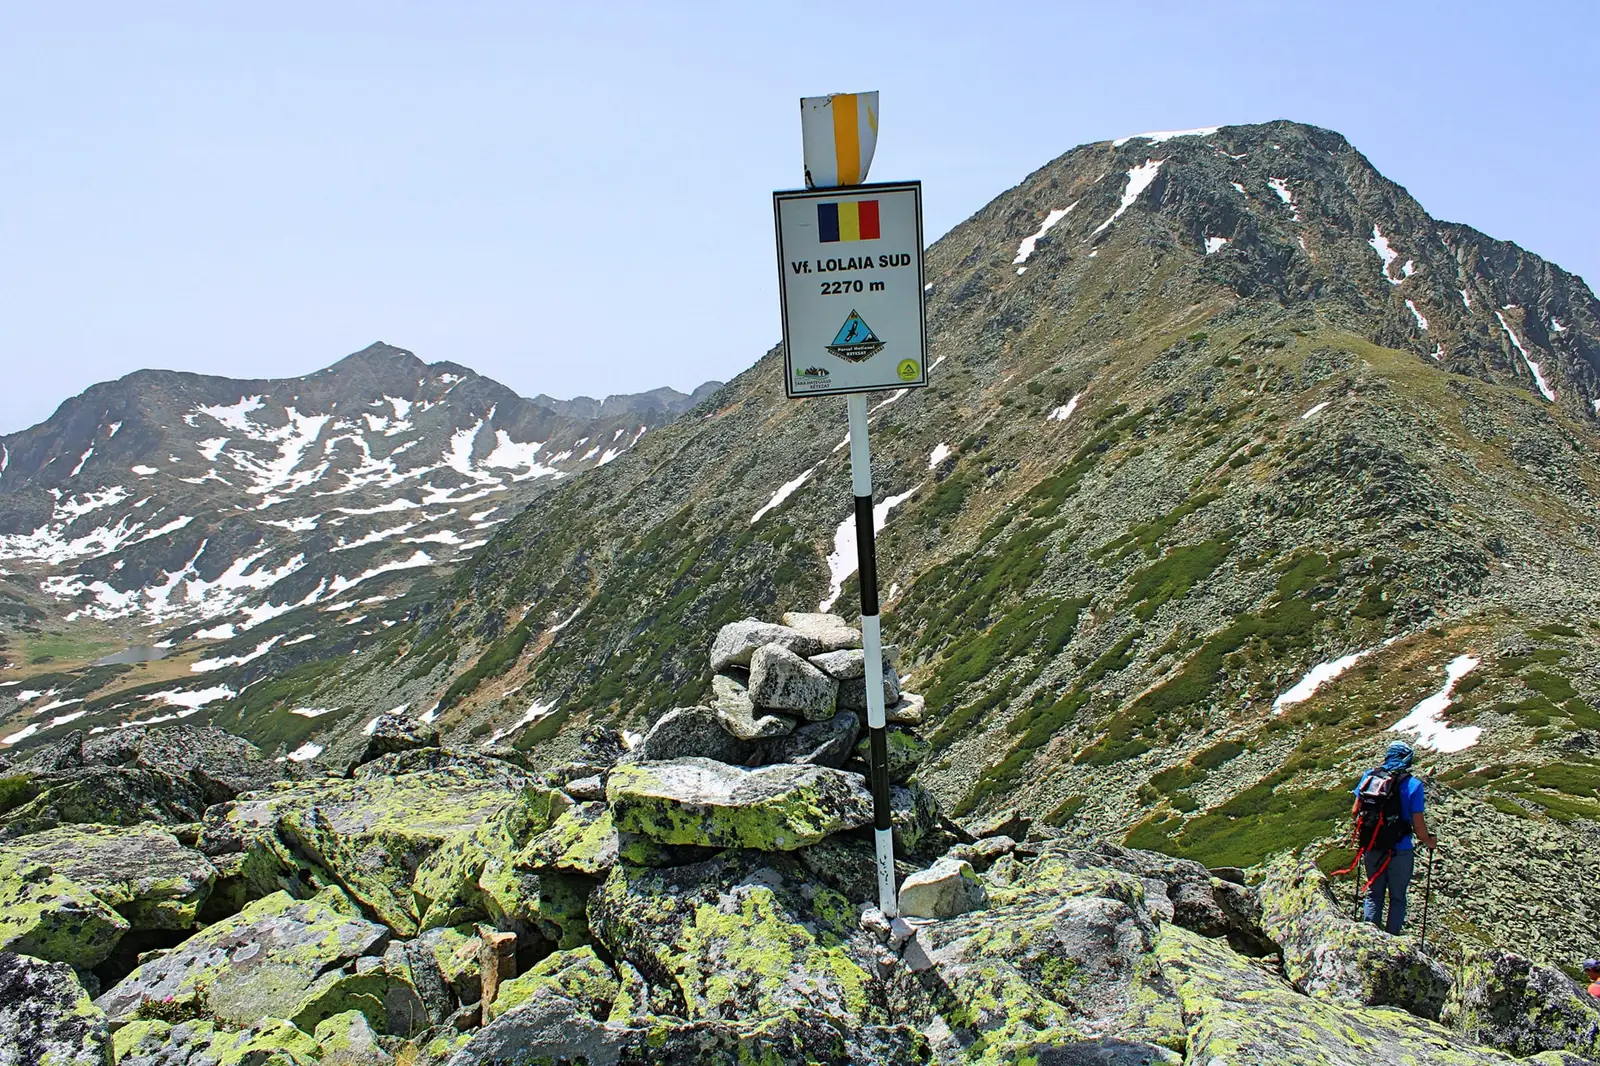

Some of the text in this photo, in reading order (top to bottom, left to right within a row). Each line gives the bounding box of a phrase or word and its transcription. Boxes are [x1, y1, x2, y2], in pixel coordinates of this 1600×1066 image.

[792, 253, 911, 274] Vf. LOLAIA SUD
[820, 280, 885, 295] 2270 m
